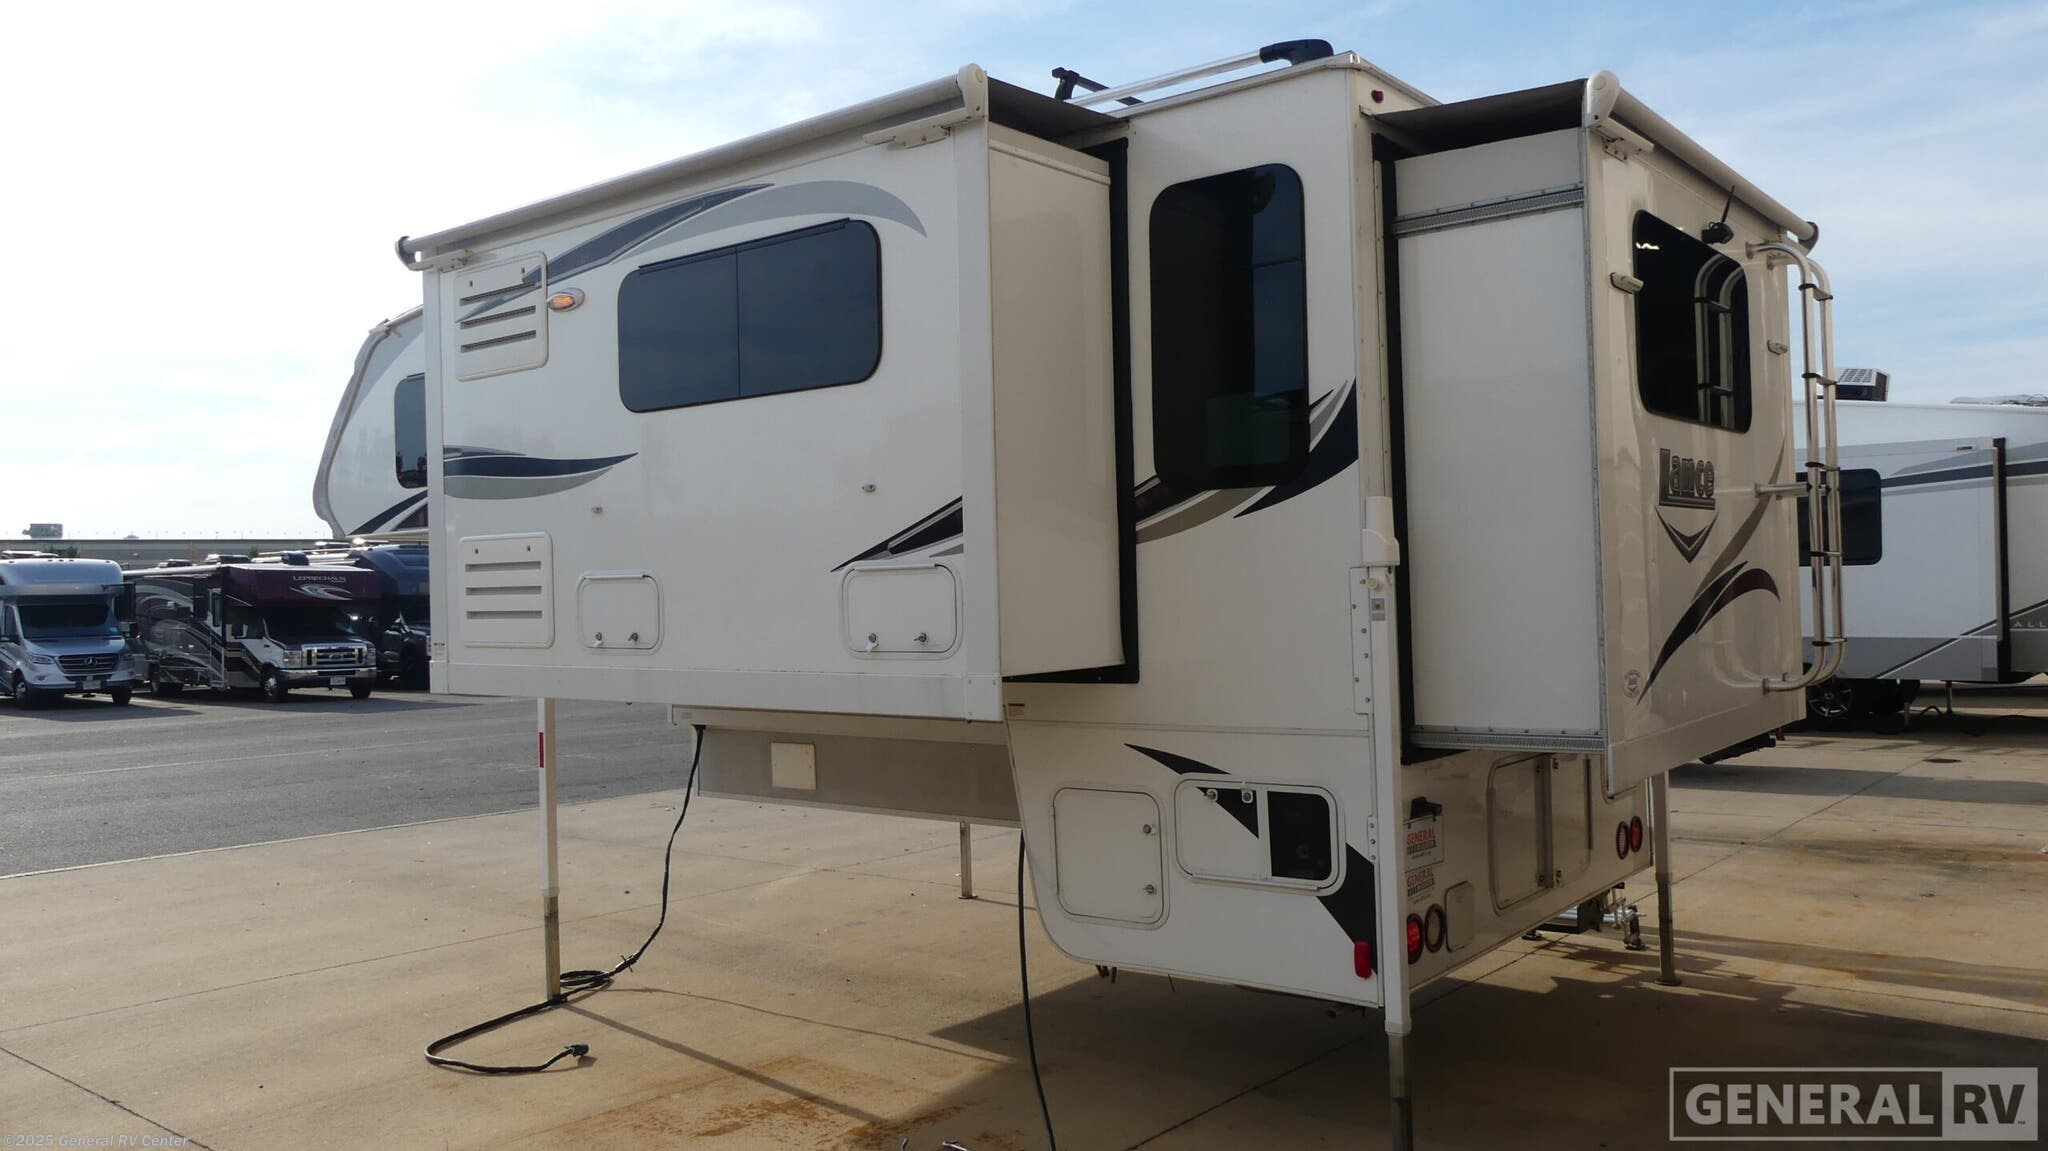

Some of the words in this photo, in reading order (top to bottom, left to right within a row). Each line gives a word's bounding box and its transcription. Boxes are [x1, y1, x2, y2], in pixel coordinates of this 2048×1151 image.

[1659, 448, 1715, 510] Lance
[1407, 827, 1436, 846] GENERAL
[1407, 866, 1434, 888] GENERAL
